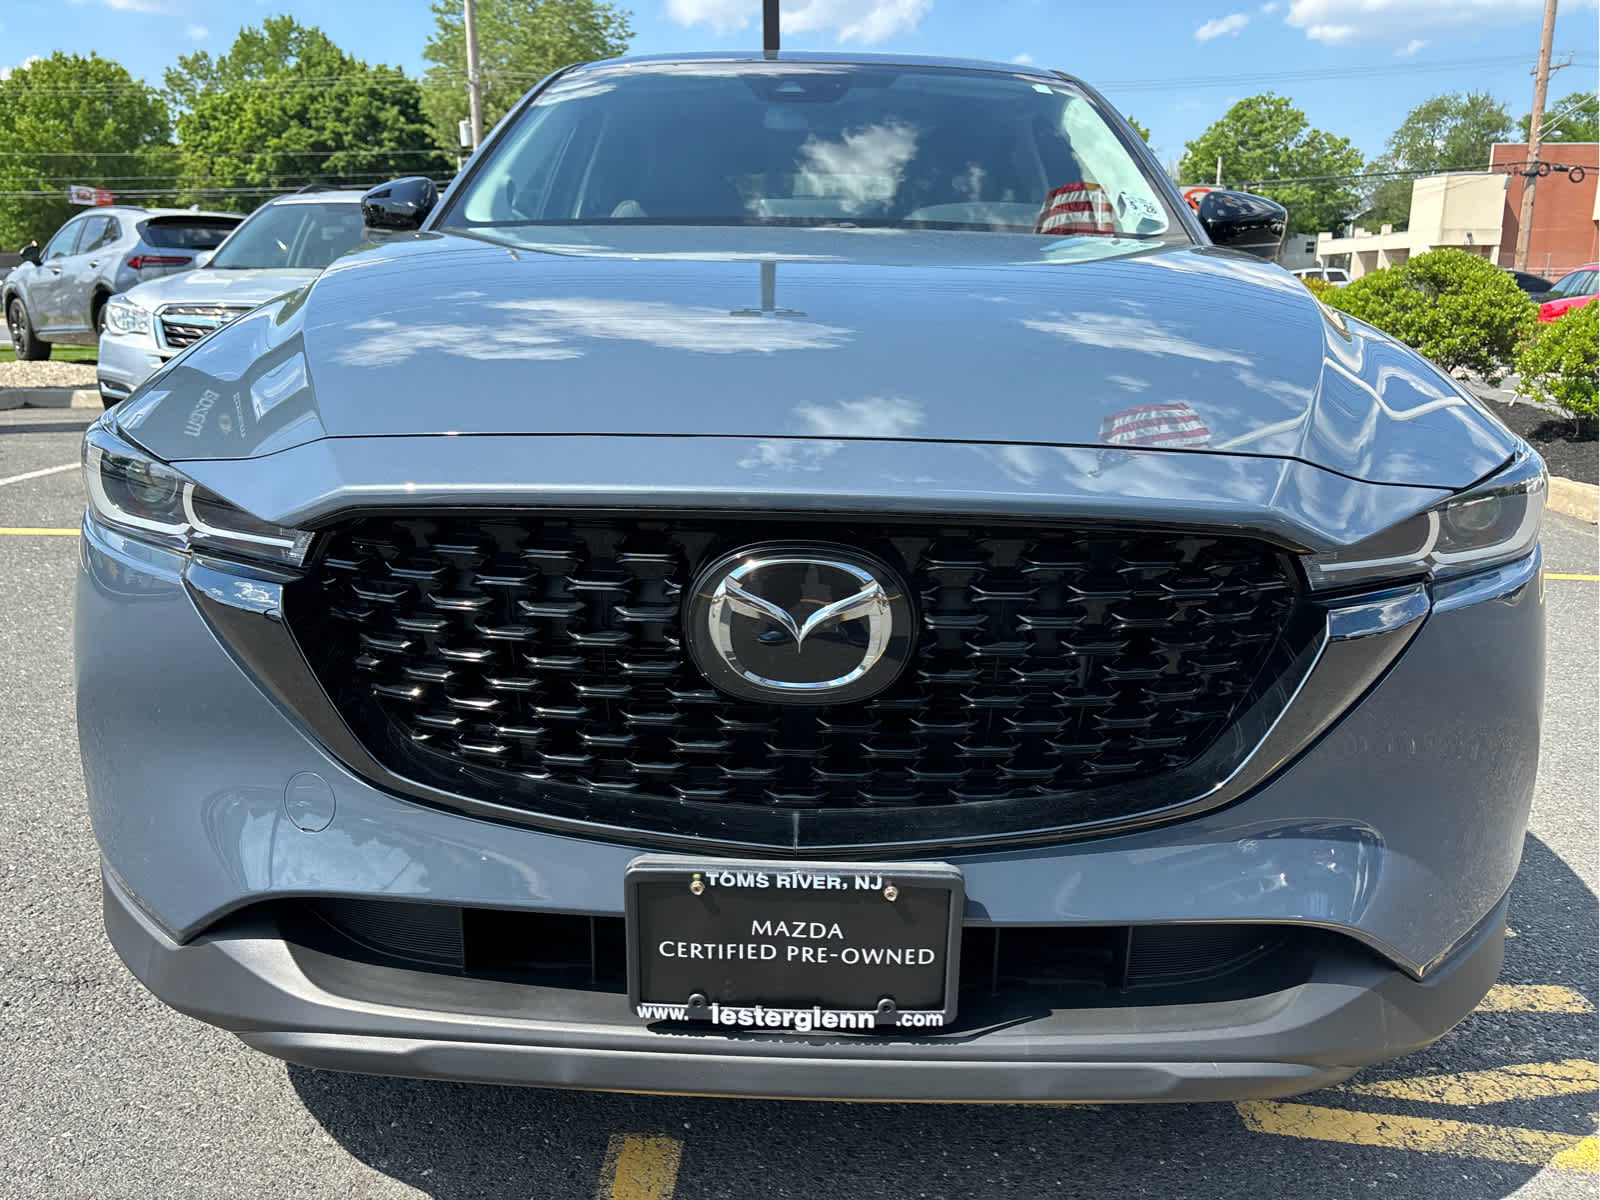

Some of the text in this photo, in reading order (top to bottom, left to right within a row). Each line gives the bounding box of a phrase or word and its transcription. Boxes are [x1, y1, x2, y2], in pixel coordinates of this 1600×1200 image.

[707, 871, 883, 891] TOMS RIVER, NJ
[751, 919, 844, 939] MAZDA
[658, 940, 935, 965] CERTIFIED PRE-OWNED
[636, 1003, 944, 1031] www. lesterglenn .com
